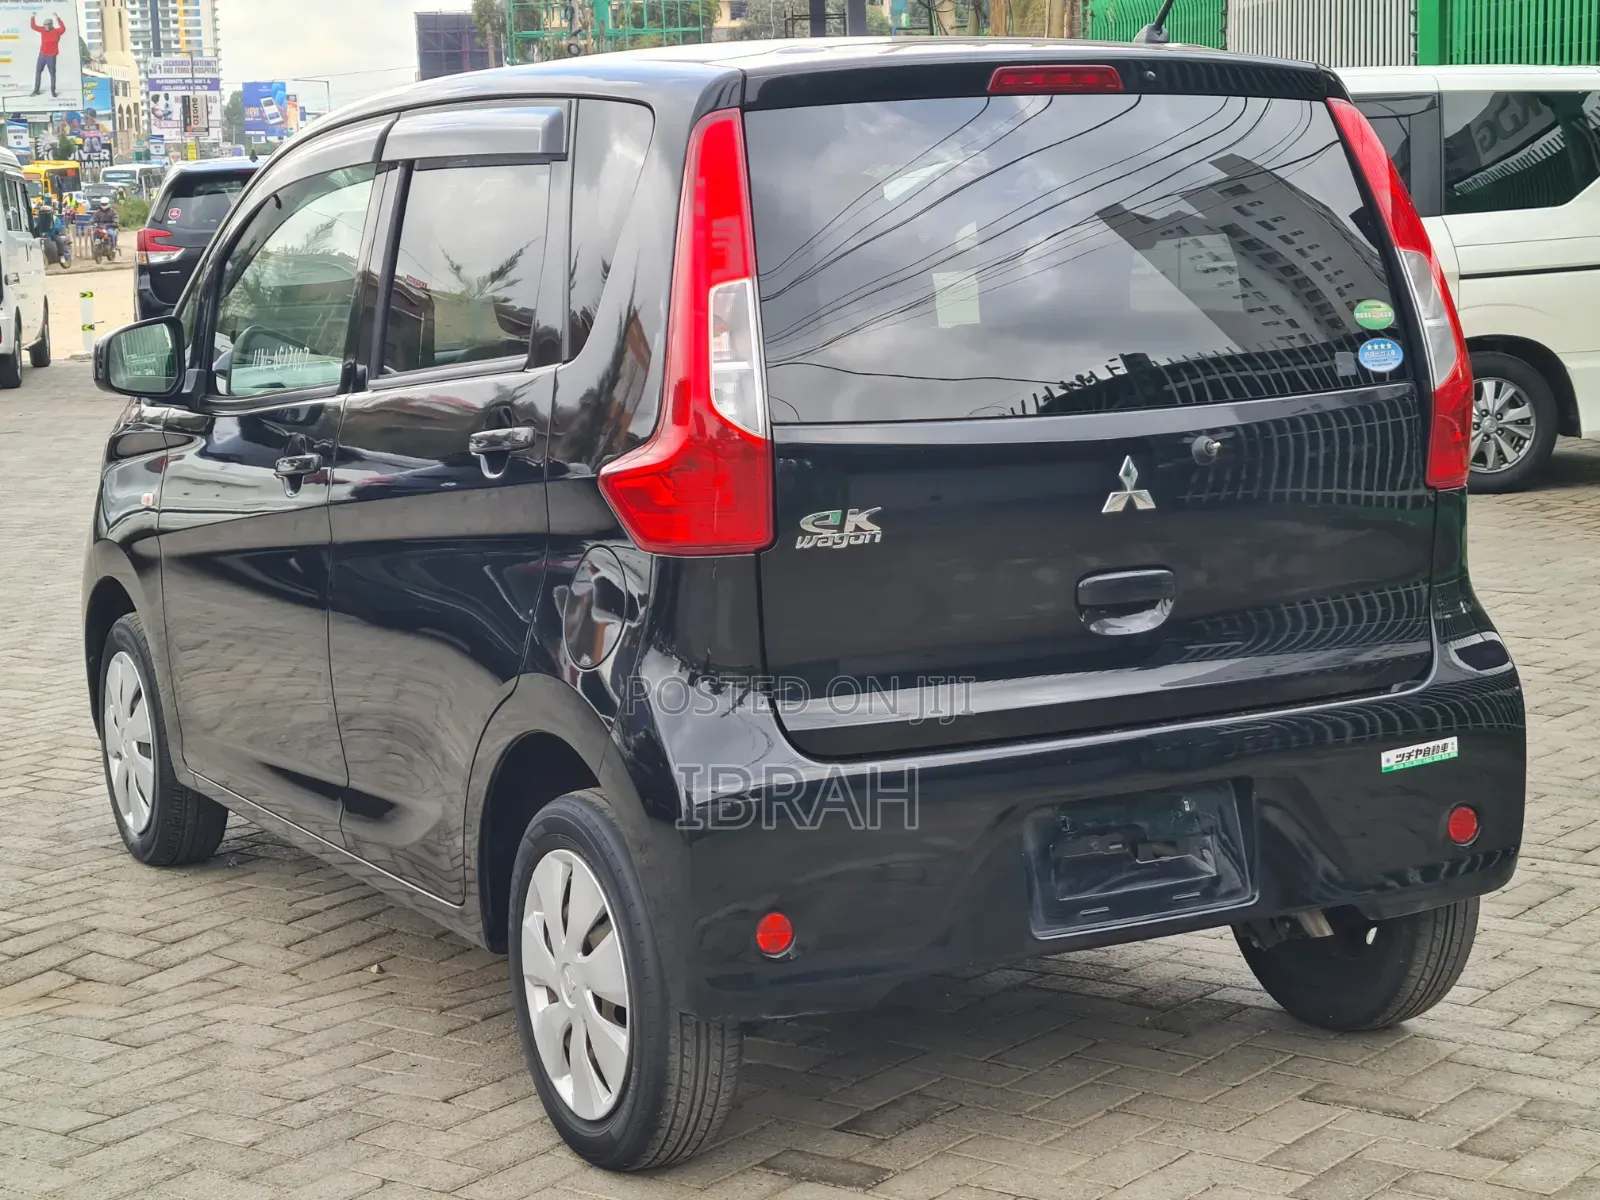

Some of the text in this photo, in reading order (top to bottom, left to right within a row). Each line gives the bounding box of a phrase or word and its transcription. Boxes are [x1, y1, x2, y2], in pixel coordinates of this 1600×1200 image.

[795, 530, 882, 549] wagon
[1395, 742, 1449, 763] ツチヤ自動車
